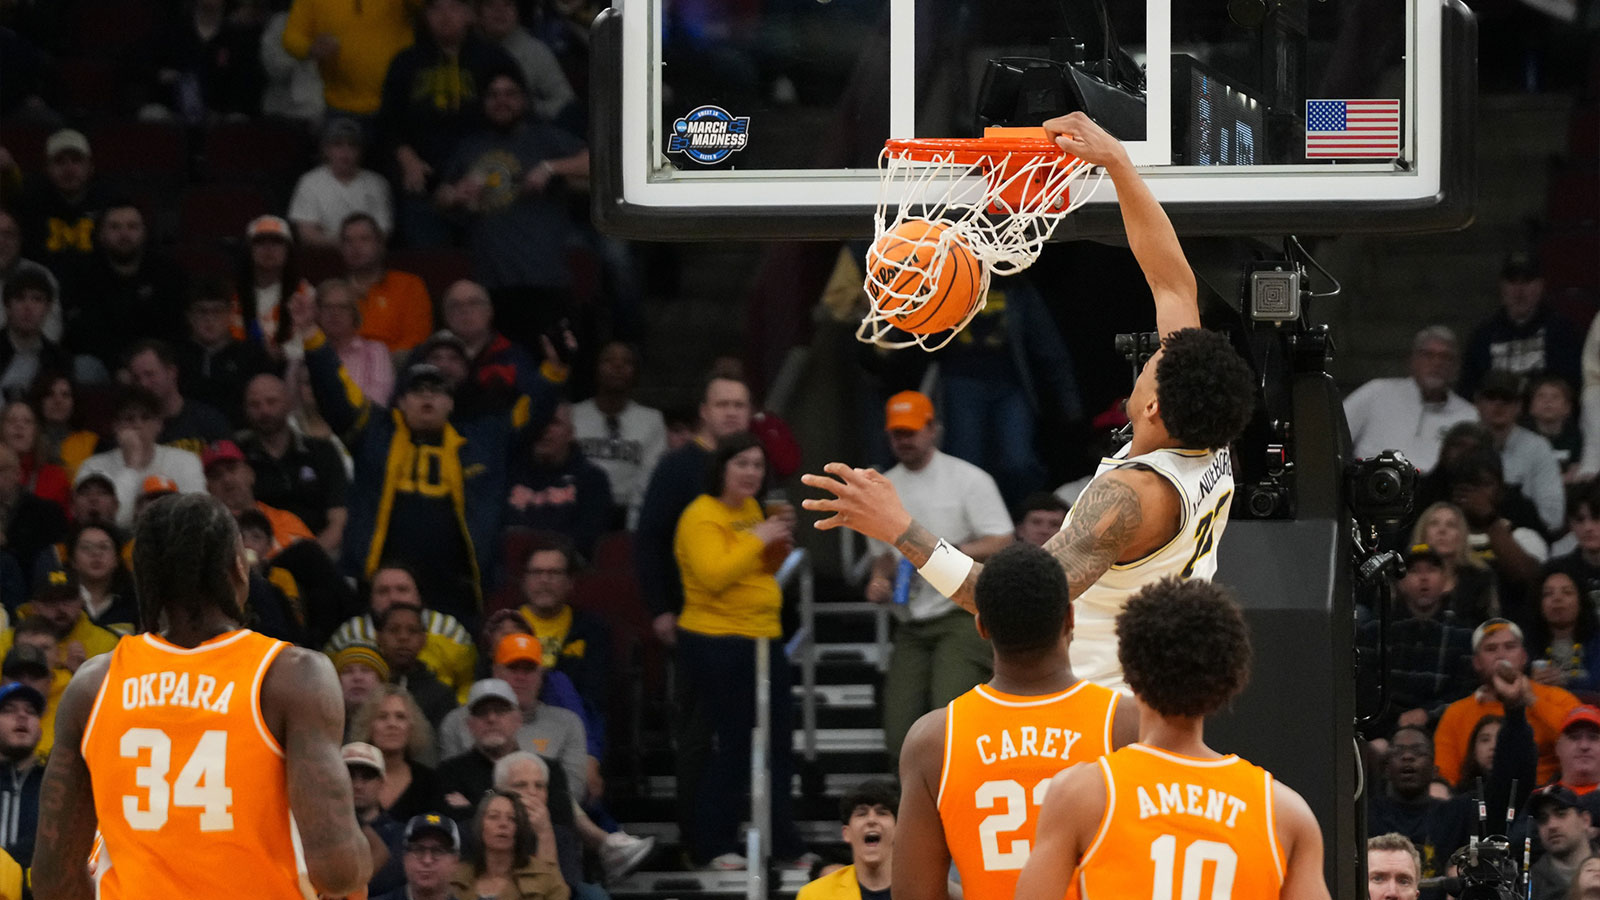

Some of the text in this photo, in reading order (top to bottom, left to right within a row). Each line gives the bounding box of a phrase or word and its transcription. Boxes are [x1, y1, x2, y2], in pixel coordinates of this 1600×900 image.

[687, 121, 728, 134] MARCH
[691, 133, 746, 146] MADNESS
[122, 670, 236, 716] OKPARA
[975, 725, 1082, 765] CAREY
[119, 726, 235, 833] 34
[974, 777, 1050, 872] 2
[1136, 782, 1247, 828] AMENT
[1150, 833, 1238, 900] 10
